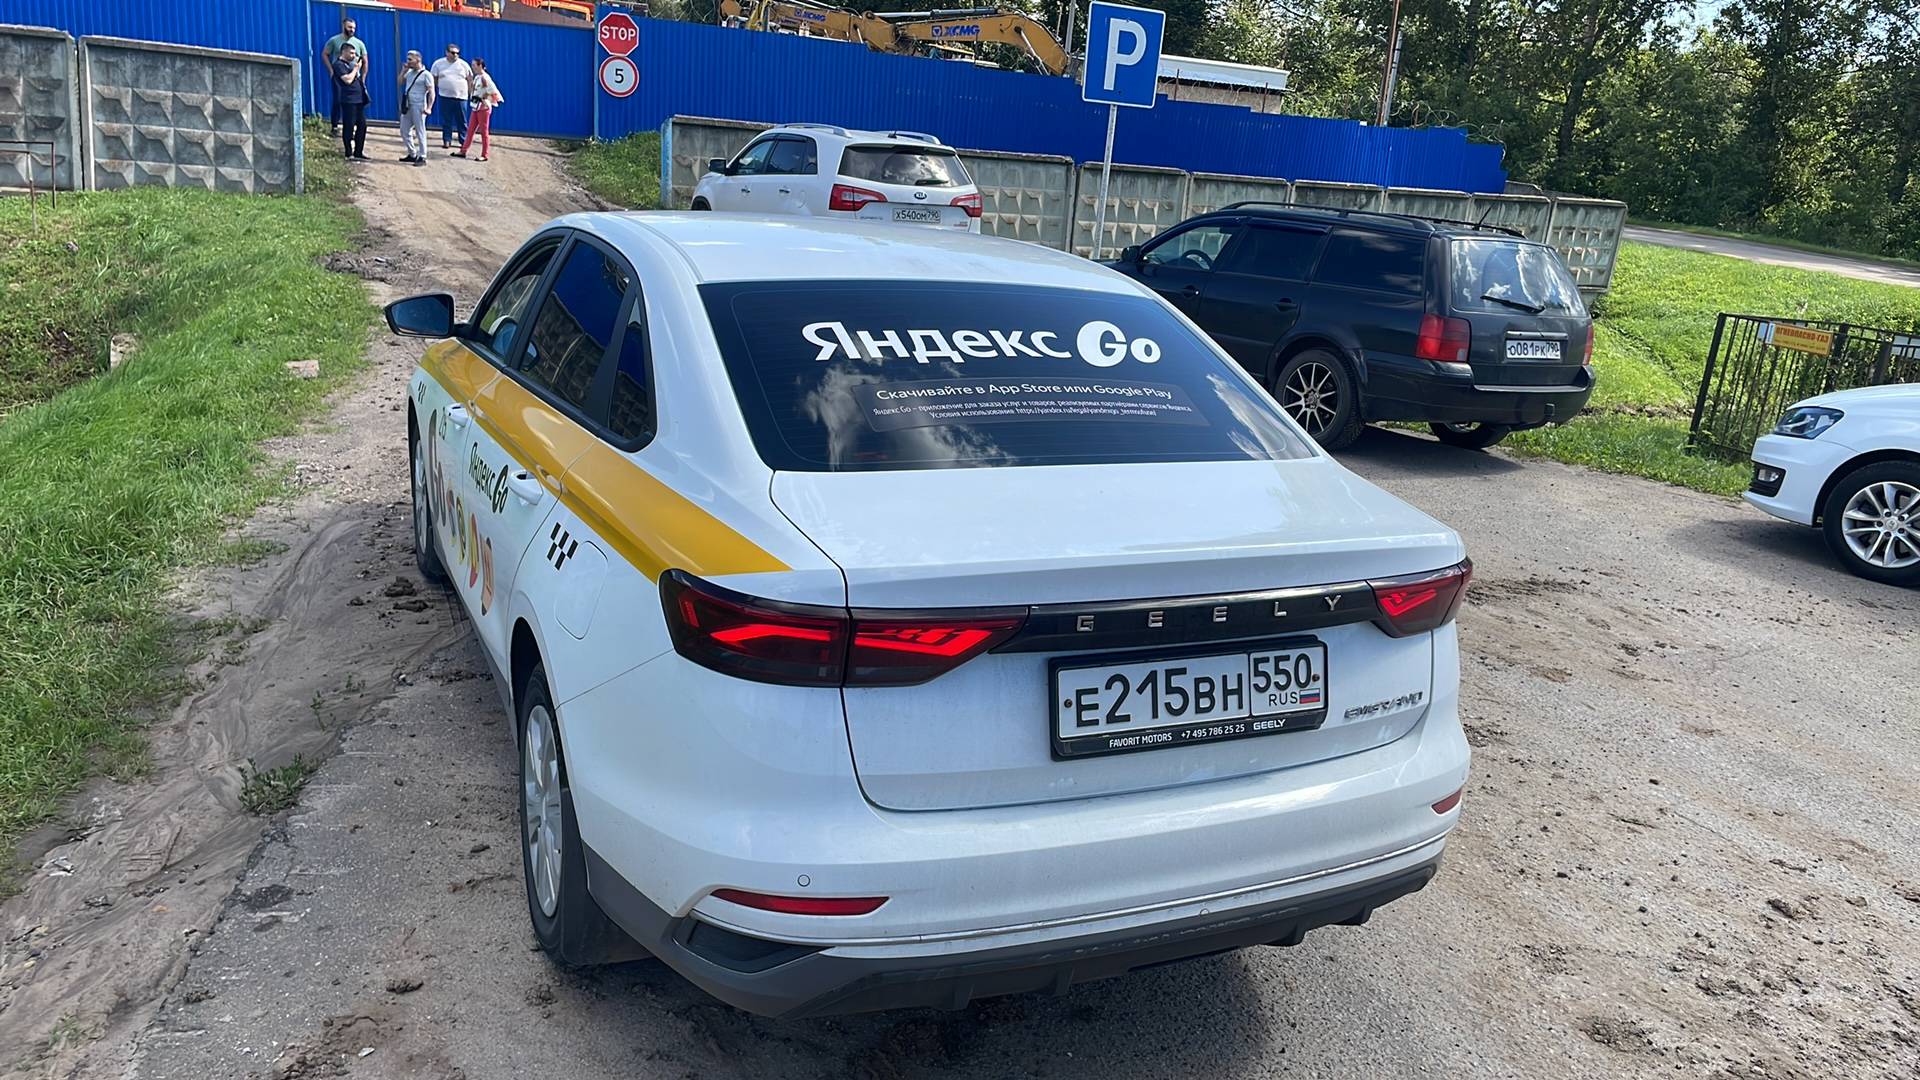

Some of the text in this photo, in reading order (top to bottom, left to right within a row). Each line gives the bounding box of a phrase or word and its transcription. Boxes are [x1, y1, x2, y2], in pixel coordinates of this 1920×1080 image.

[601, 25, 636, 41] STOP
[944, 24, 980, 37] XCMG
[1103, 17, 1147, 91] P
[614, 68, 625, 84] 5
[802, 320, 1162, 367] Яндекс Go
[876, 383, 1172, 400] Скачивайте в App Store или Google Play
[873, 407, 900, 416] Яндекс
[900, 405, 912, 414] Go
[918, 403, 964, 412] приложение
[929, 410, 961, 419] Условия
[468, 441, 509, 514] Яндекс Go
[1076, 594, 1341, 632] GEELY
[1252, 653, 1313, 694] 550
[1268, 691, 1299, 707] RUS
[1109, 718, 1286, 749] FAVORIT MOTORS +7 495 786 25 25 GEELY
